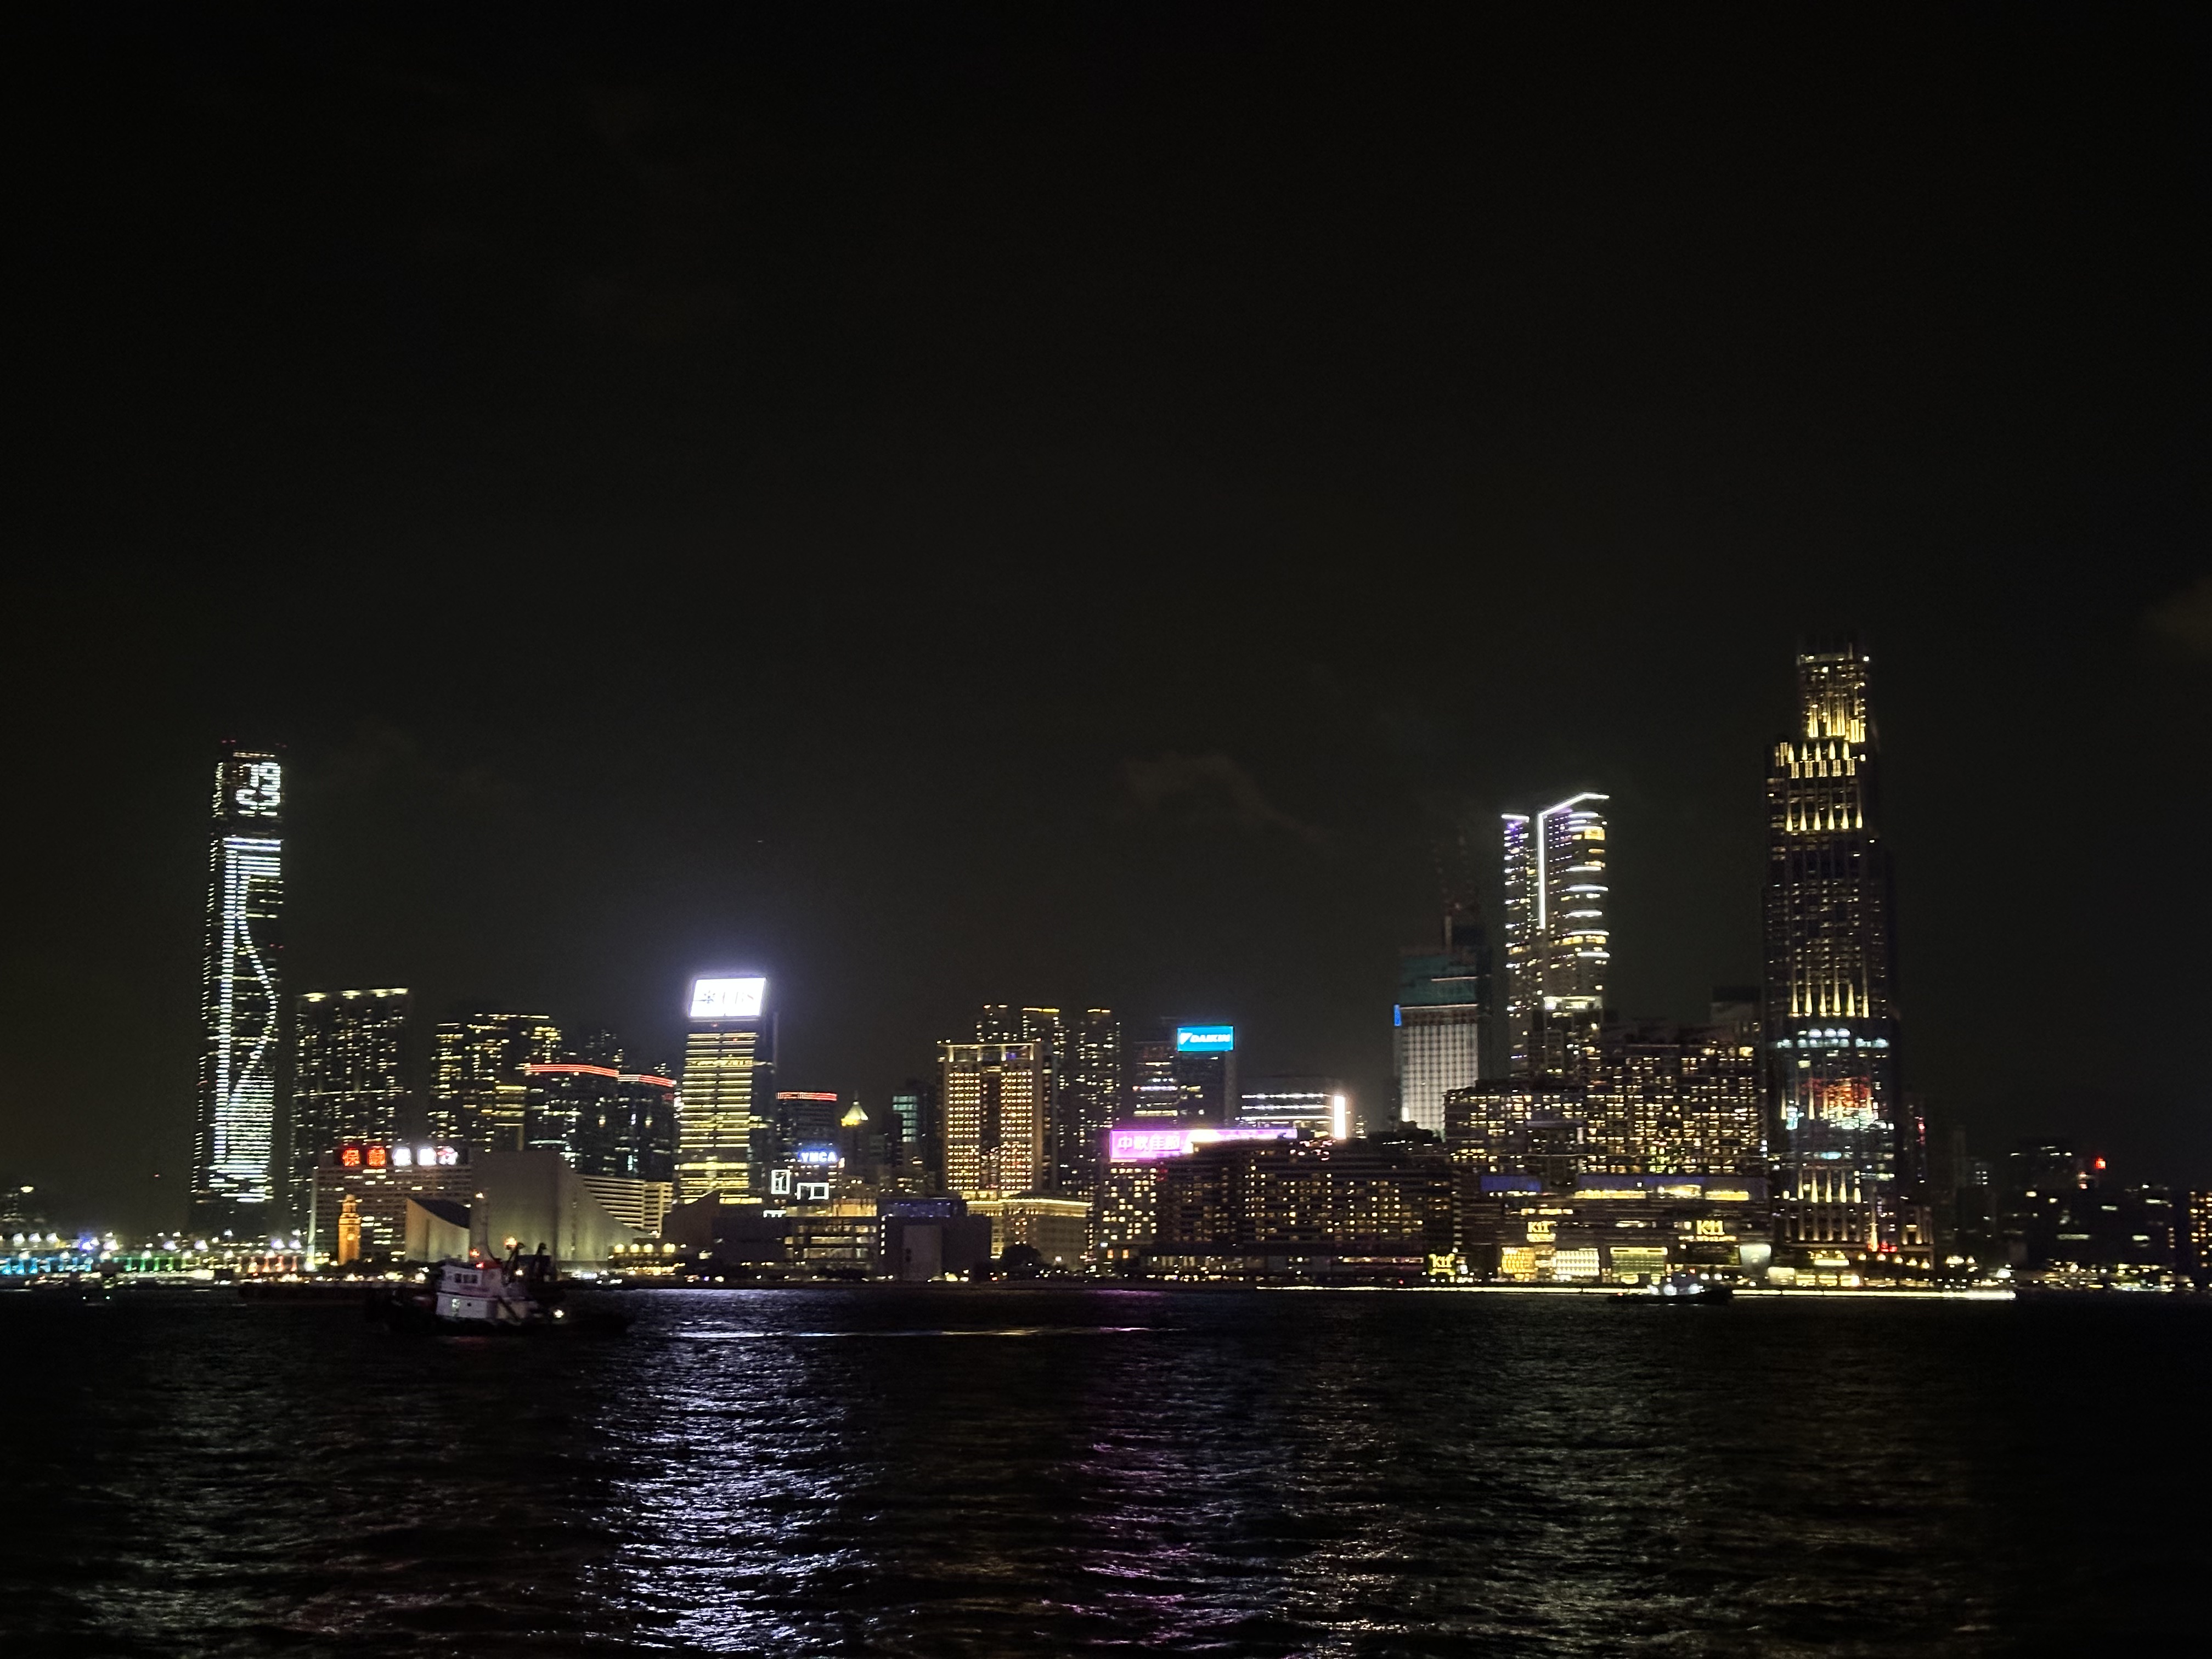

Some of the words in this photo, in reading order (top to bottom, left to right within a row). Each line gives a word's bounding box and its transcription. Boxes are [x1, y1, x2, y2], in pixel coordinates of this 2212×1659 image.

[801, 1152, 836, 1162] YMCA
[1528, 1221, 1549, 1233] K11
[1696, 1220, 1725, 1235] K11
[1432, 1256, 1452, 1268] K11
